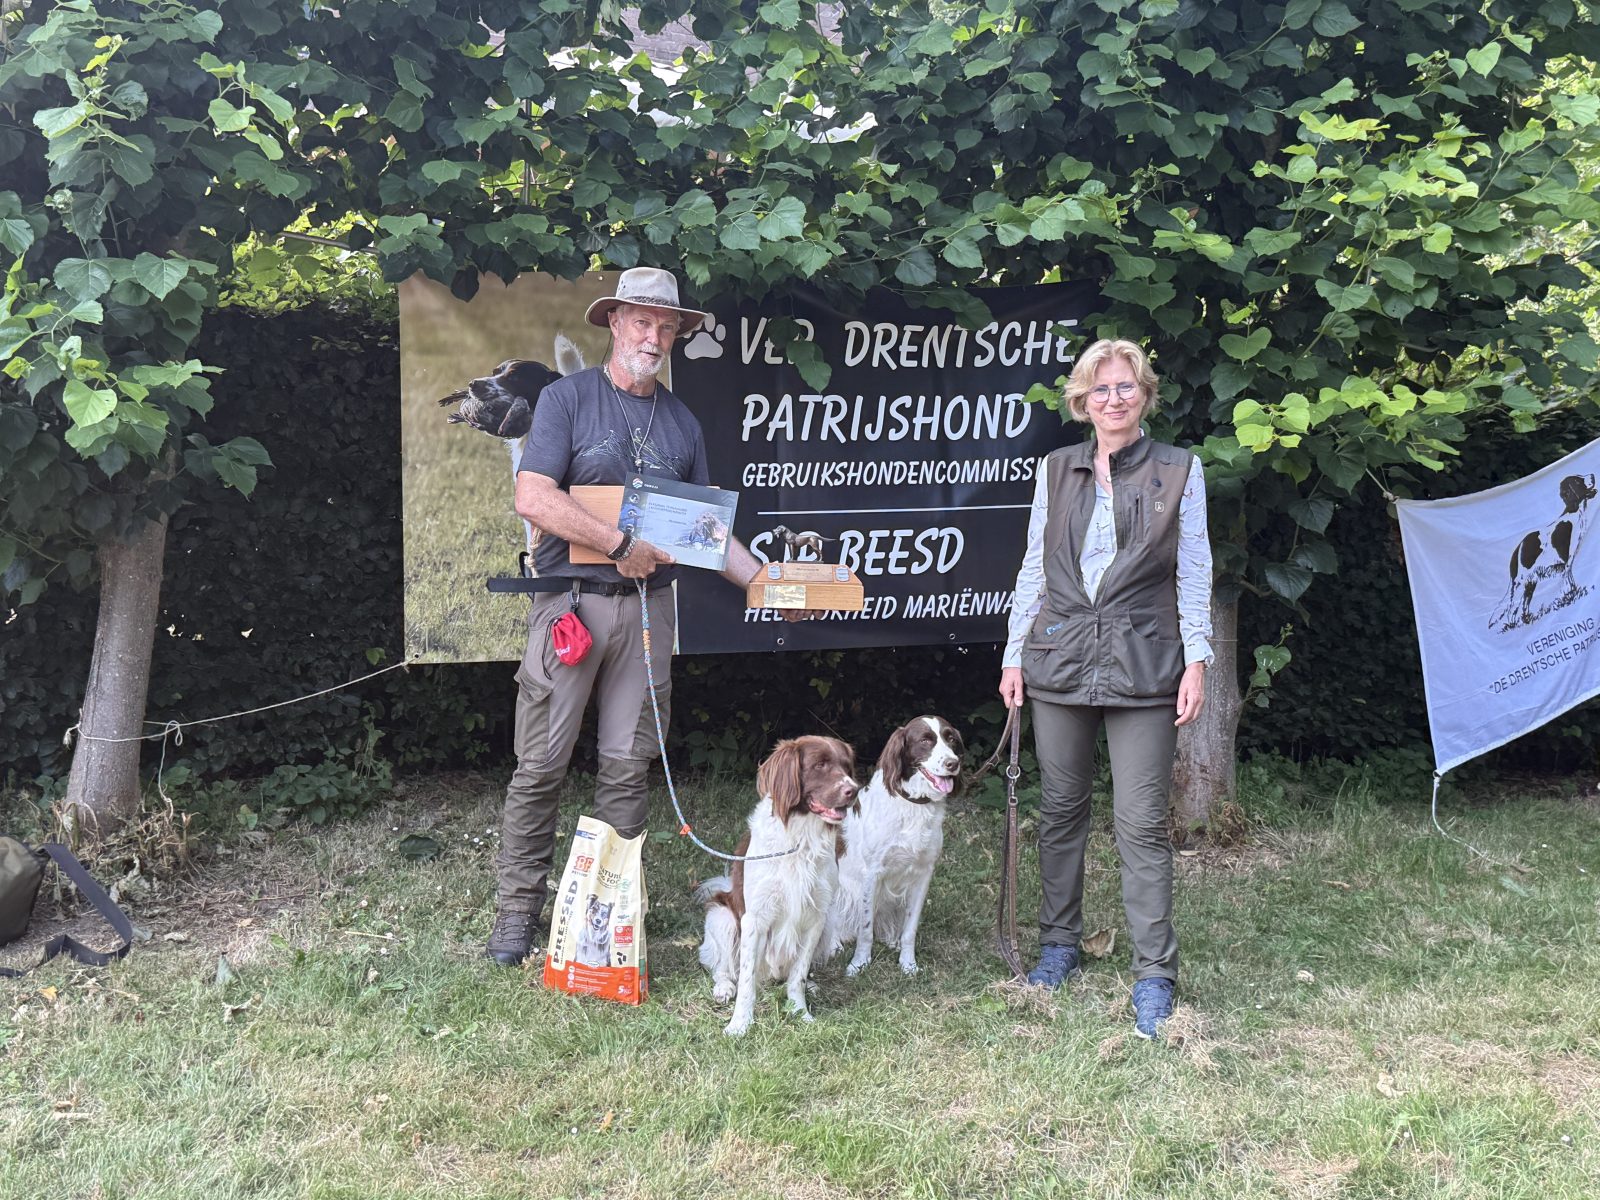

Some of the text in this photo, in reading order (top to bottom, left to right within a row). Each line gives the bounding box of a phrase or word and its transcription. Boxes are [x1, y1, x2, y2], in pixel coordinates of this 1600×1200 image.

[844, 318, 1079, 371] DRENTSCHE
[741, 393, 1032, 444] PATRIJSHOND
[840, 526, 965, 576] BEESD
[1526, 617, 1595, 656] VERENIGING
[1508, 647, 1571, 686] DRENTSCHE
[553, 879, 578, 965] PRESSED
